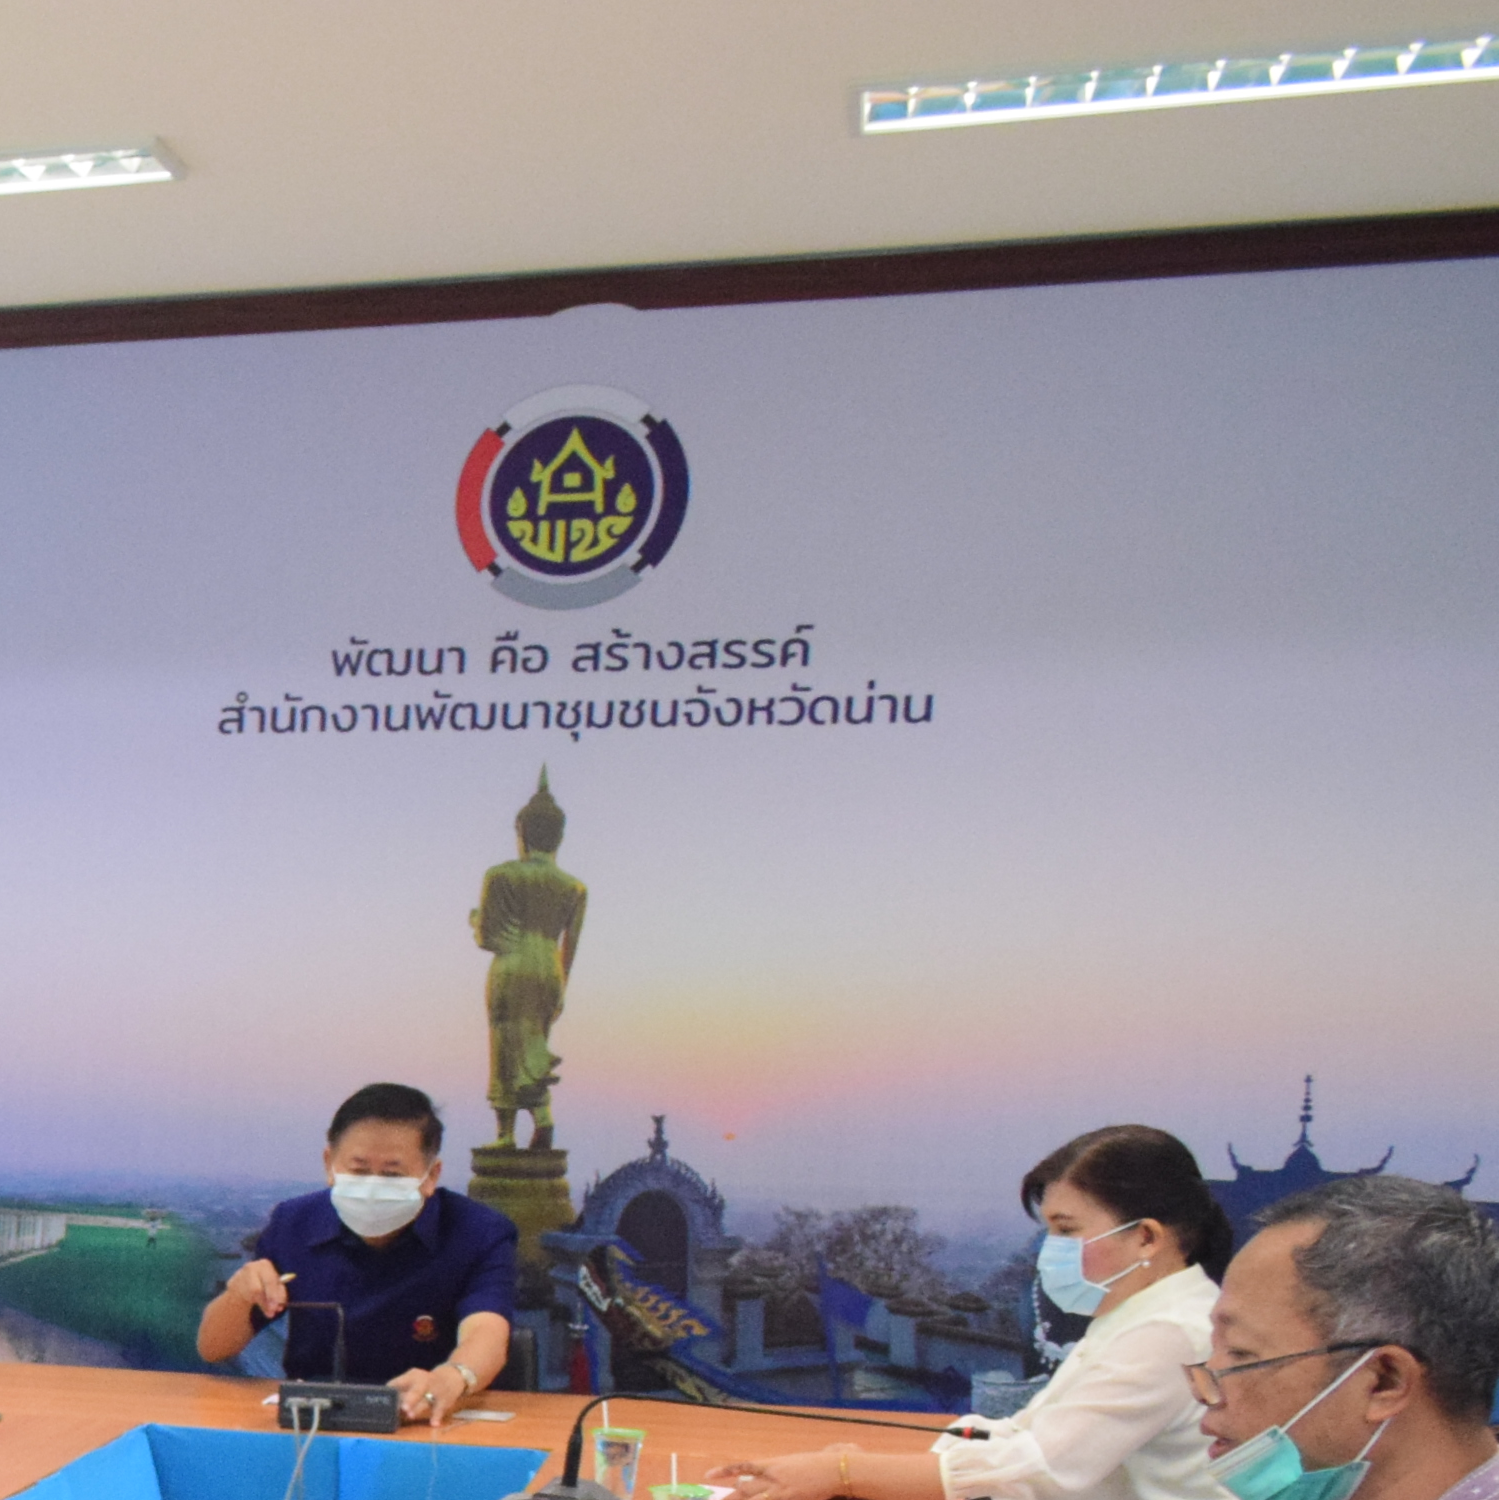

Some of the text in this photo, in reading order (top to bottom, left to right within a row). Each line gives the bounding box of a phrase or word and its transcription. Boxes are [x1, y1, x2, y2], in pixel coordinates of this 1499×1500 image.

[330, 623, 816, 678] พัฒนา คือ สร้างสรรค์
[216, 679, 935, 743] สำนักงานพัฒนาชุมชนจังหวัดน่าน
